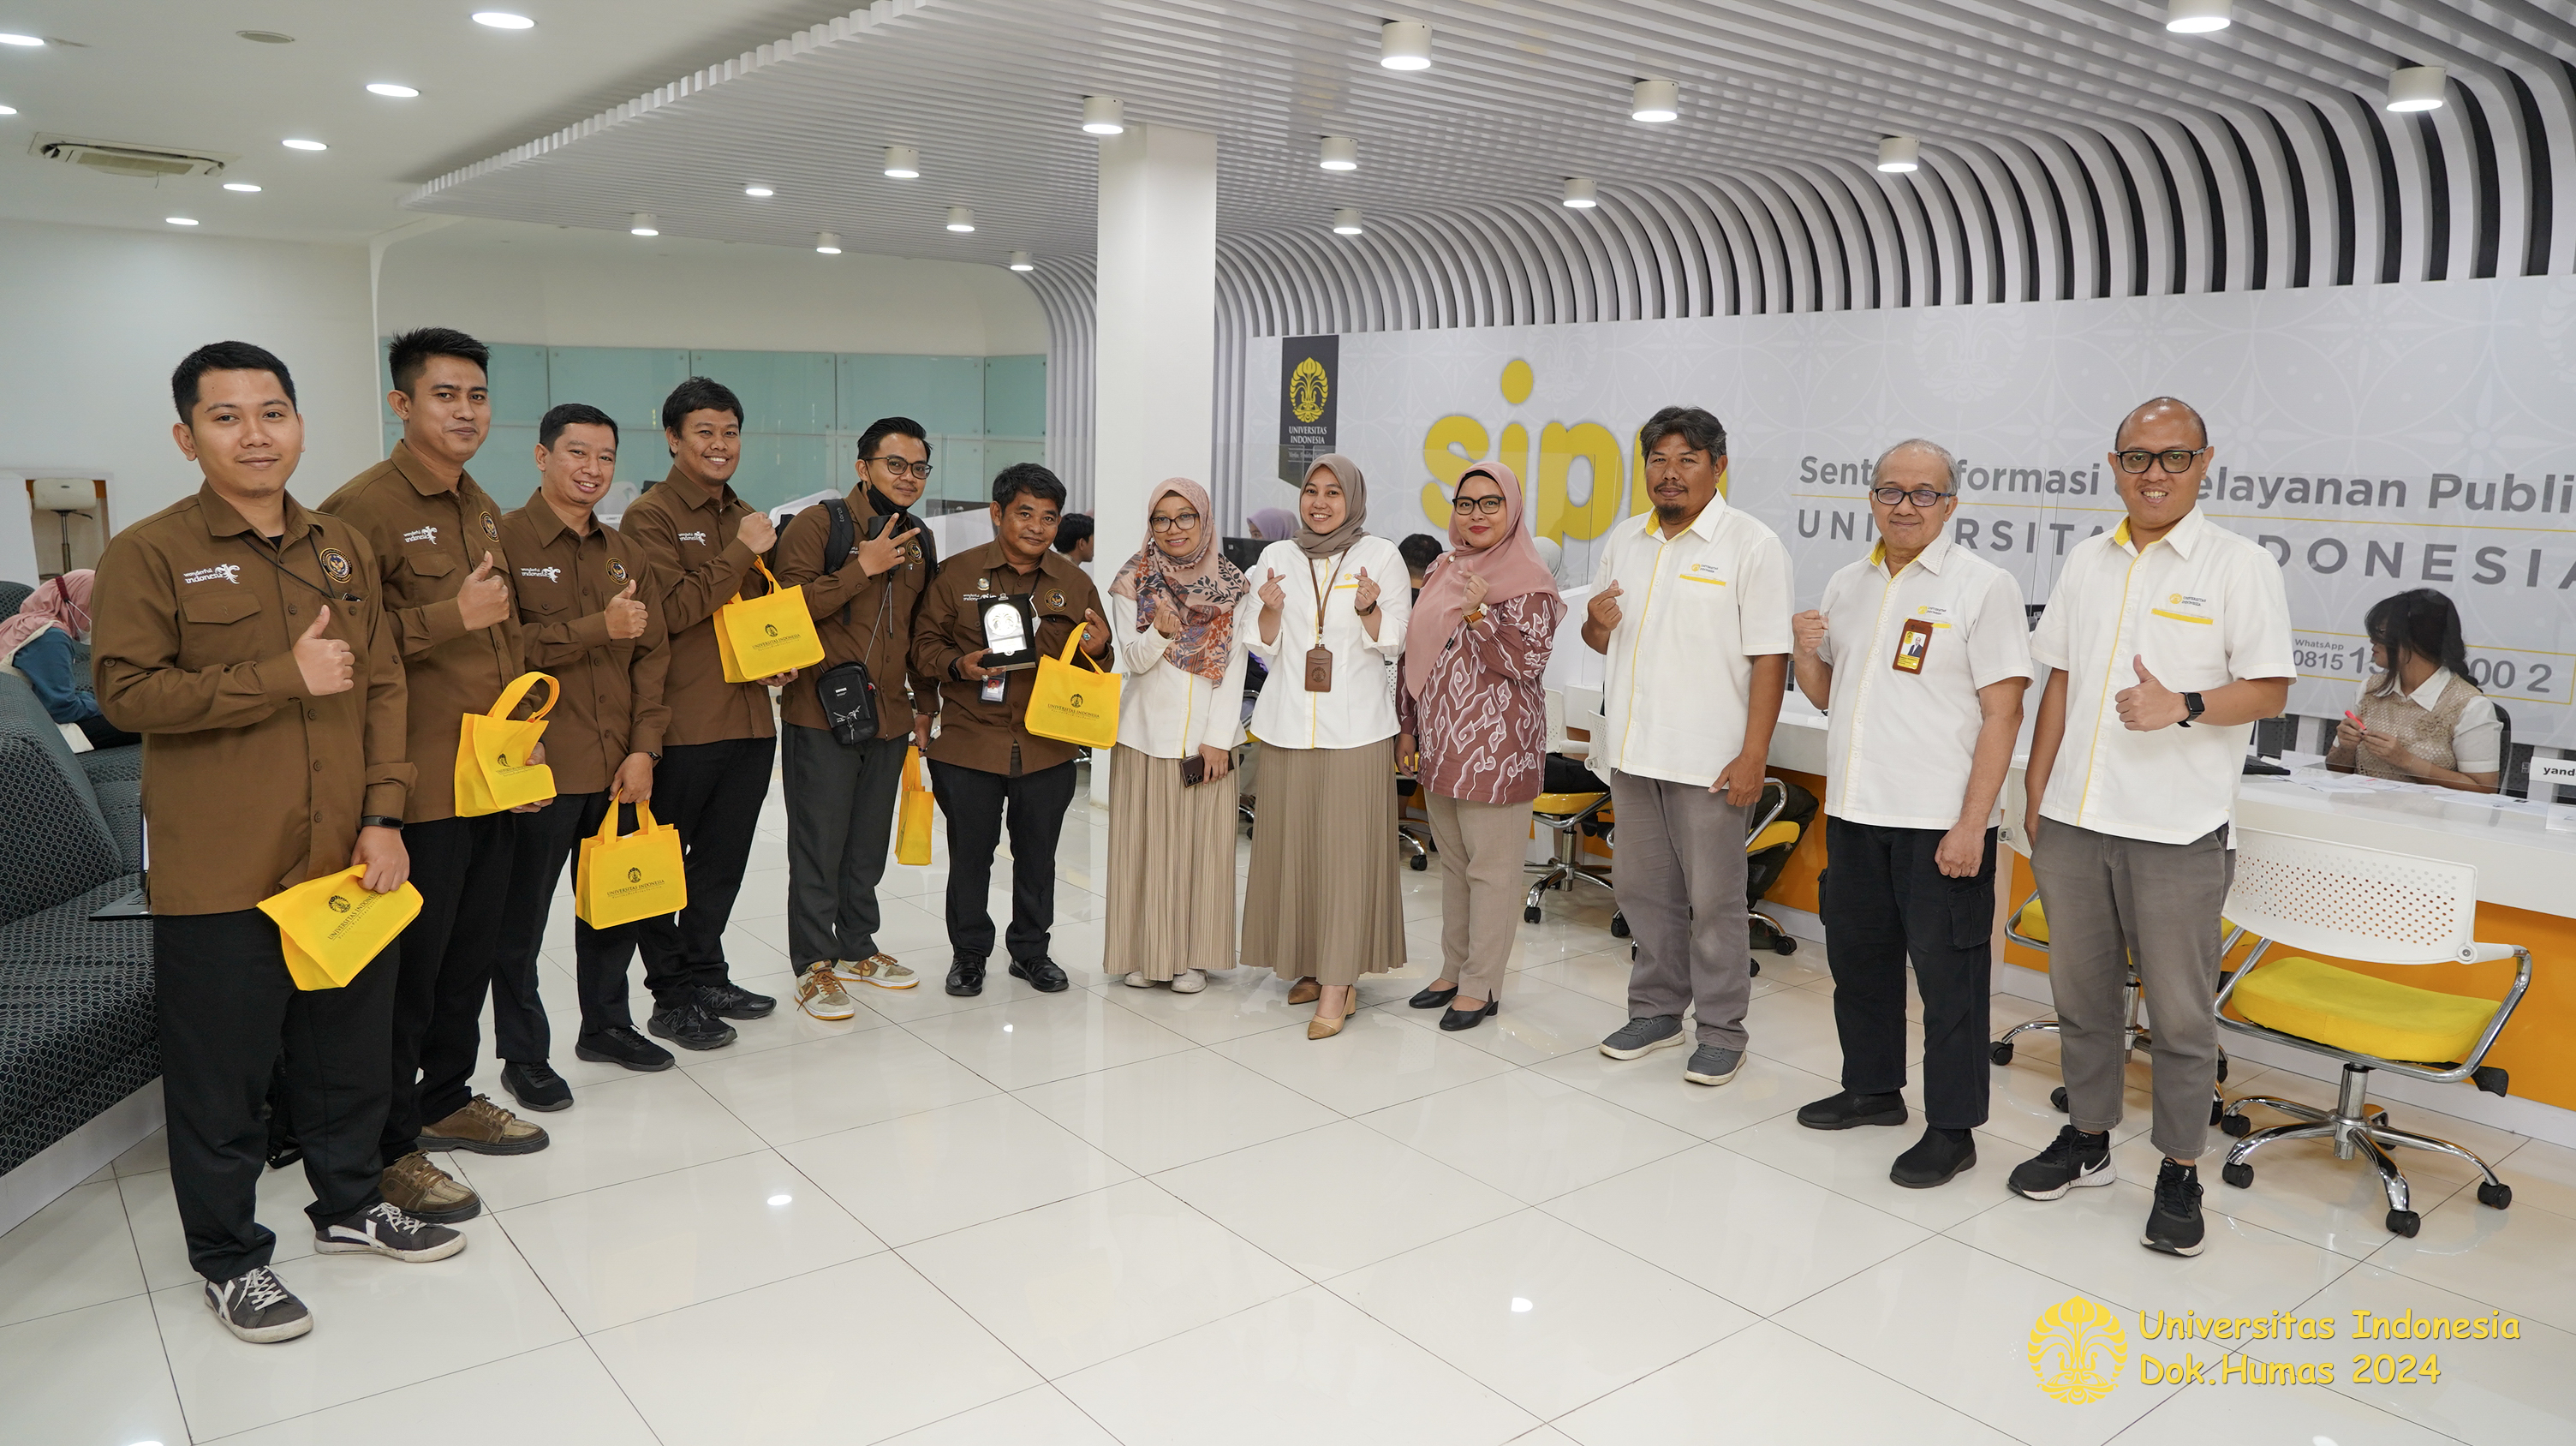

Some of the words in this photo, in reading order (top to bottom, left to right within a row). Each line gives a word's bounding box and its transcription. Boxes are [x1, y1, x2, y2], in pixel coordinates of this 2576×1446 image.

[1288, 426, 1327, 435] UNIVERSITAS
[1291, 435, 1325, 445] INDONESIA
[1422, 360, 1727, 550] sip
[1799, 456, 1874, 486] Sent
[1957, 458, 2101, 495] formasi
[2197, 467, 2407, 510] elayanan
[1798, 509, 2104, 555] UNIRSIT
[2257, 535, 2576, 589] DONESI
[2295, 638, 2344, 651] WhatsApp
[2293, 649, 2344, 671] 0815
[2526, 663, 2552, 693] 2
[327, 911, 357, 940] UNIVERSITAS
[355, 890, 379, 912] INDONESI
